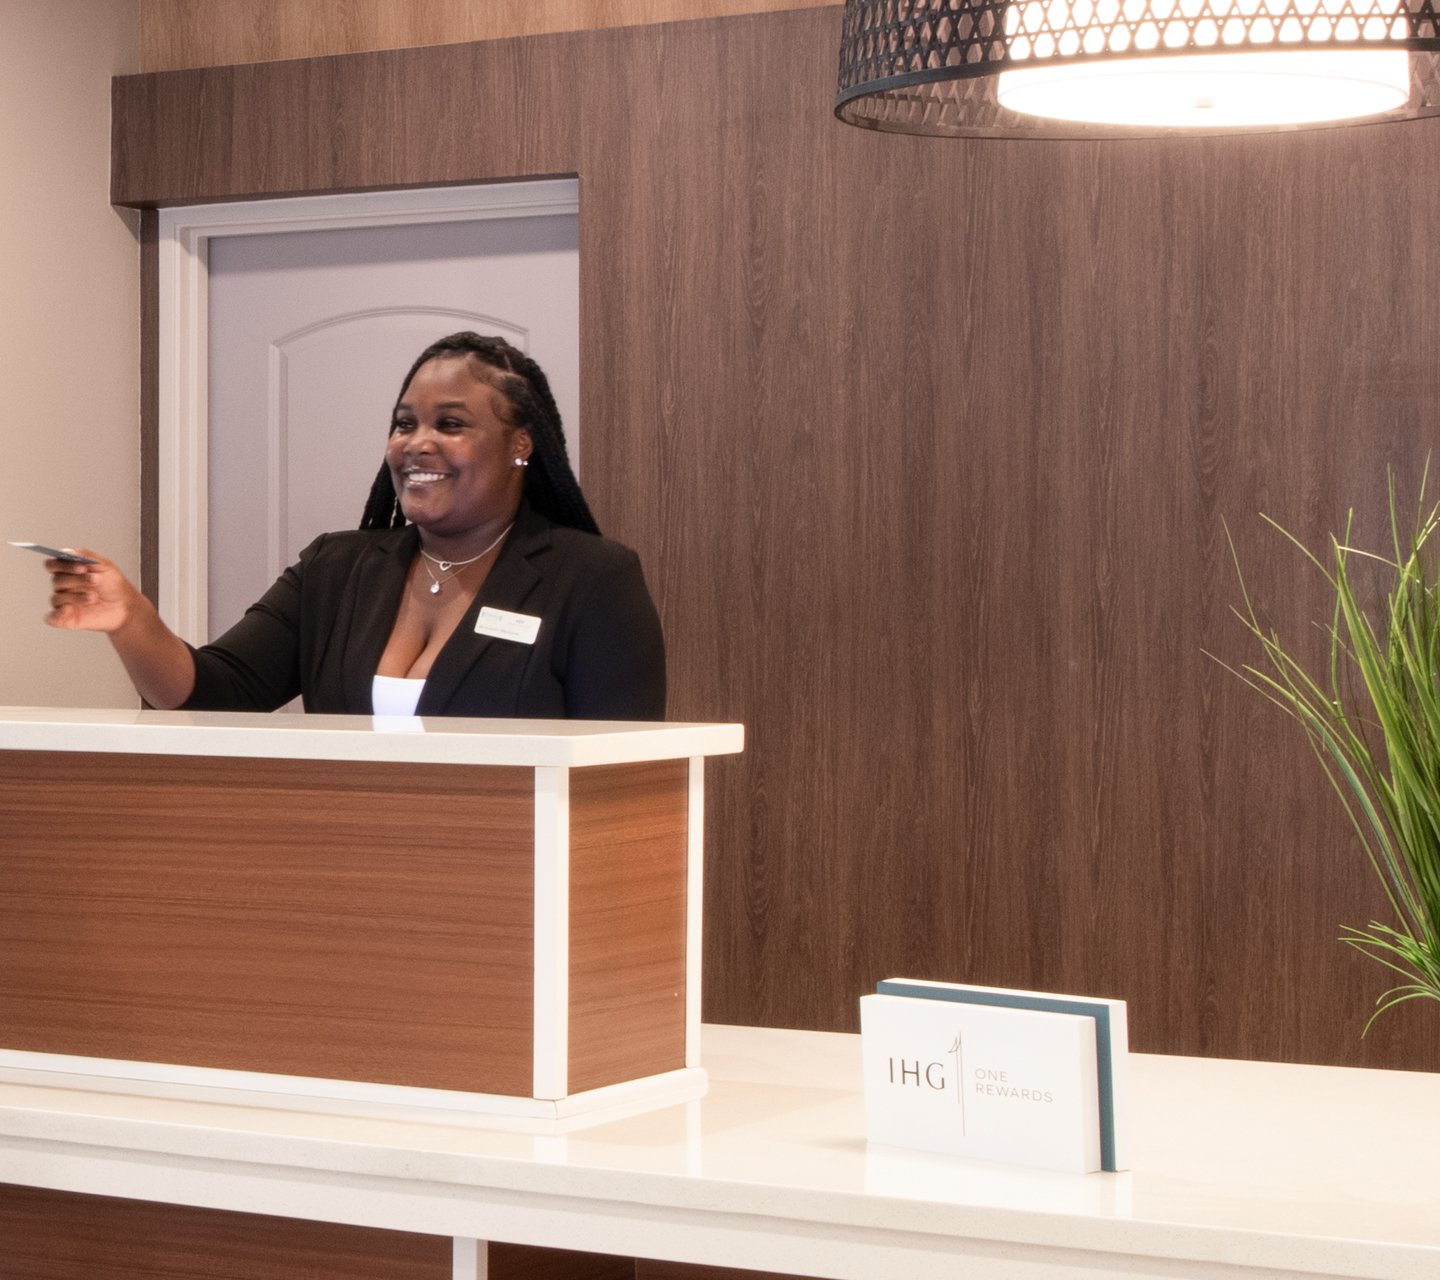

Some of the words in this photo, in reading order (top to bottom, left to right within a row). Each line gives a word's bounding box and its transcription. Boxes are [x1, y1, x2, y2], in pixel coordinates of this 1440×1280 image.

[889, 1057, 945, 1091] IHG
[974, 1068, 1008, 1083] ONE
[975, 1082, 1054, 1104] REWARDS
